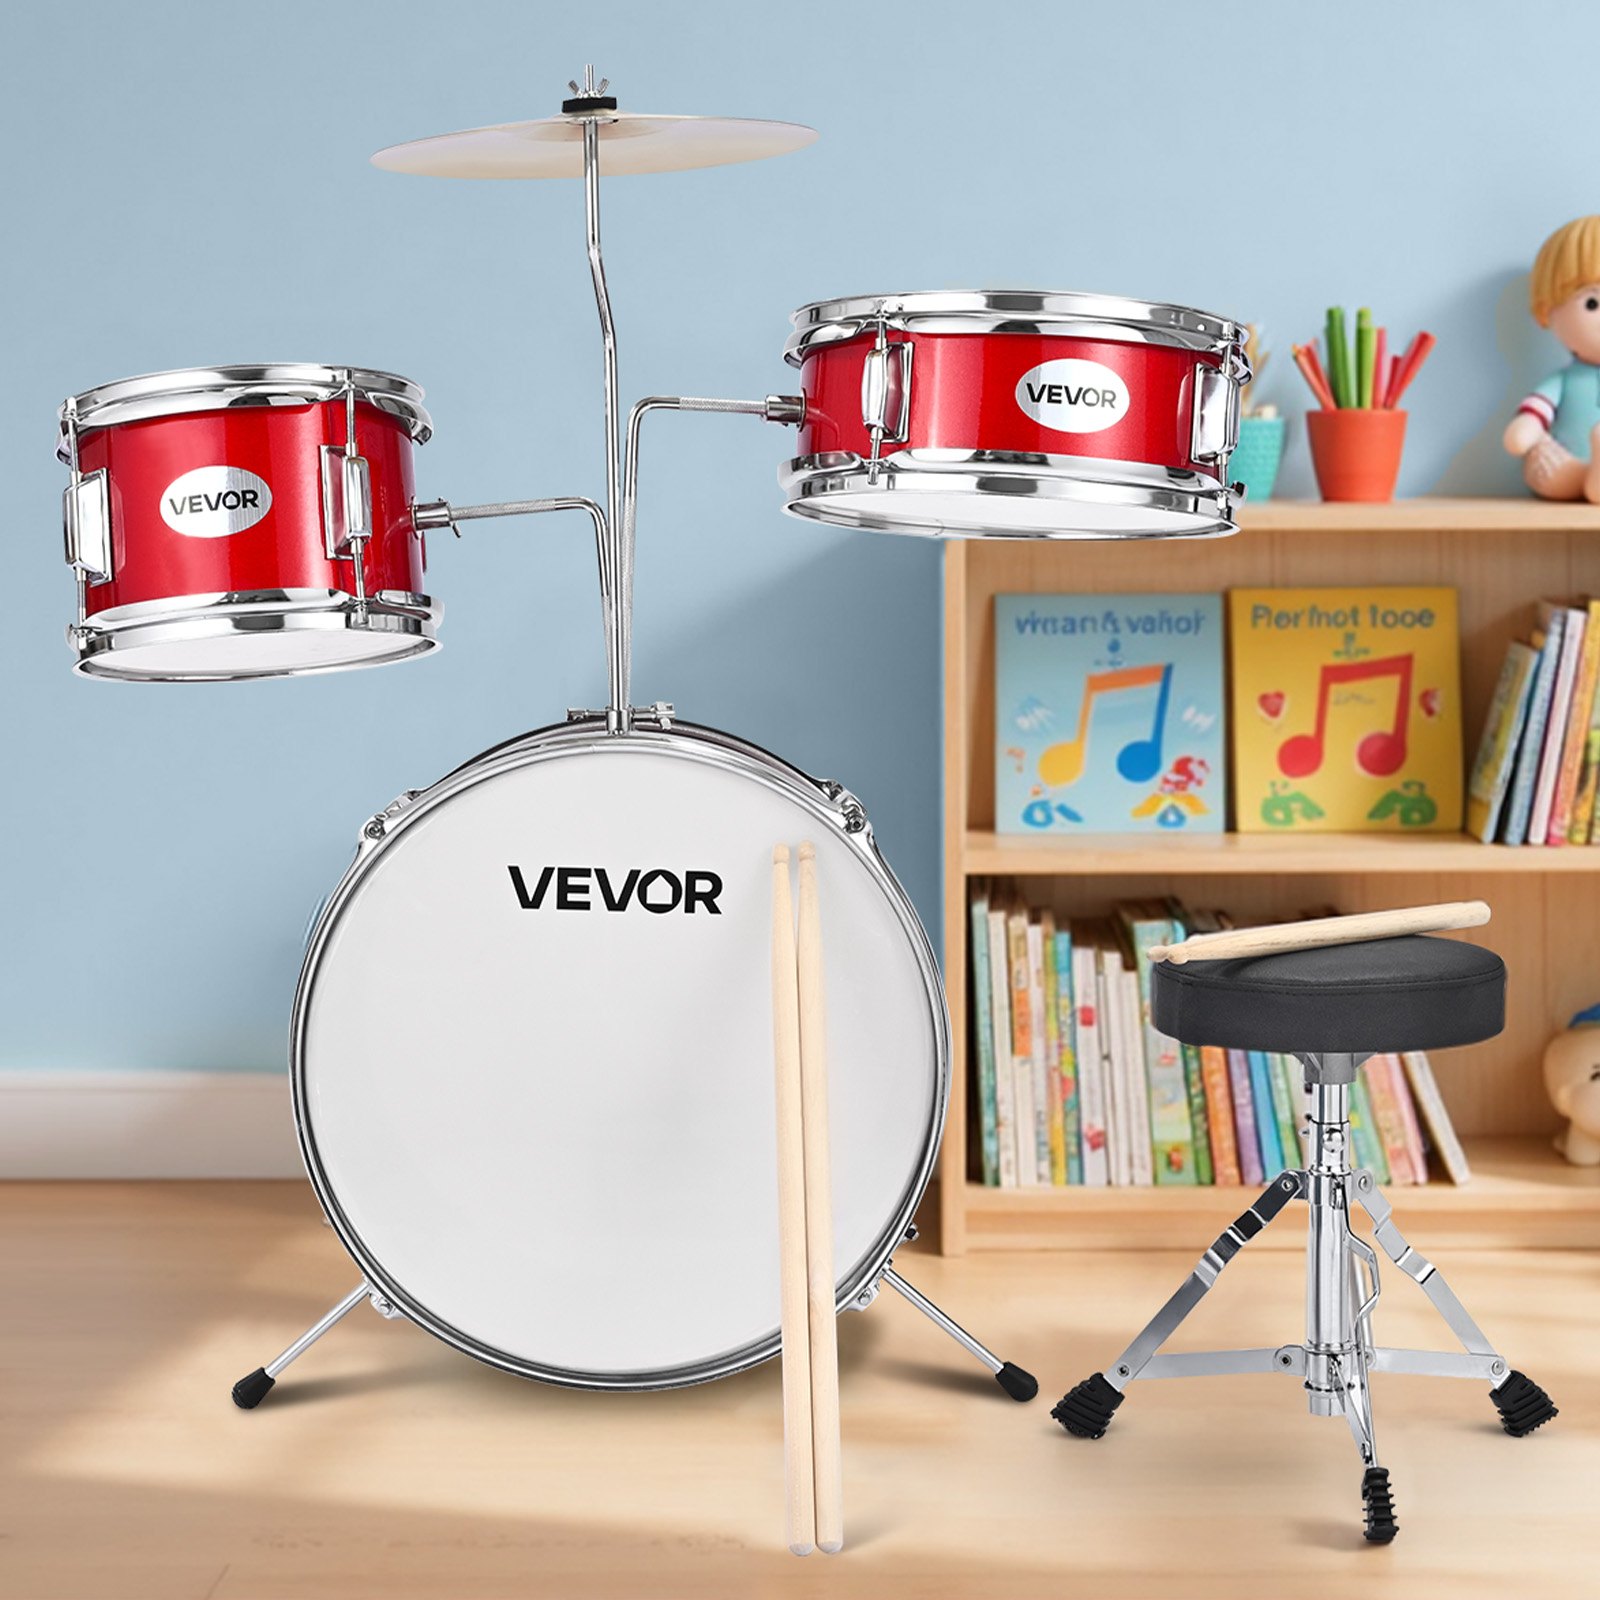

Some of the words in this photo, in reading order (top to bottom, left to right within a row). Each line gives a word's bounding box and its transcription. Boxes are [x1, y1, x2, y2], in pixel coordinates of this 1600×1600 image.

[1026, 382, 1116, 409] VEVOR
[169, 489, 259, 515] VEVOR
[508, 866, 722, 915] VEVOR
